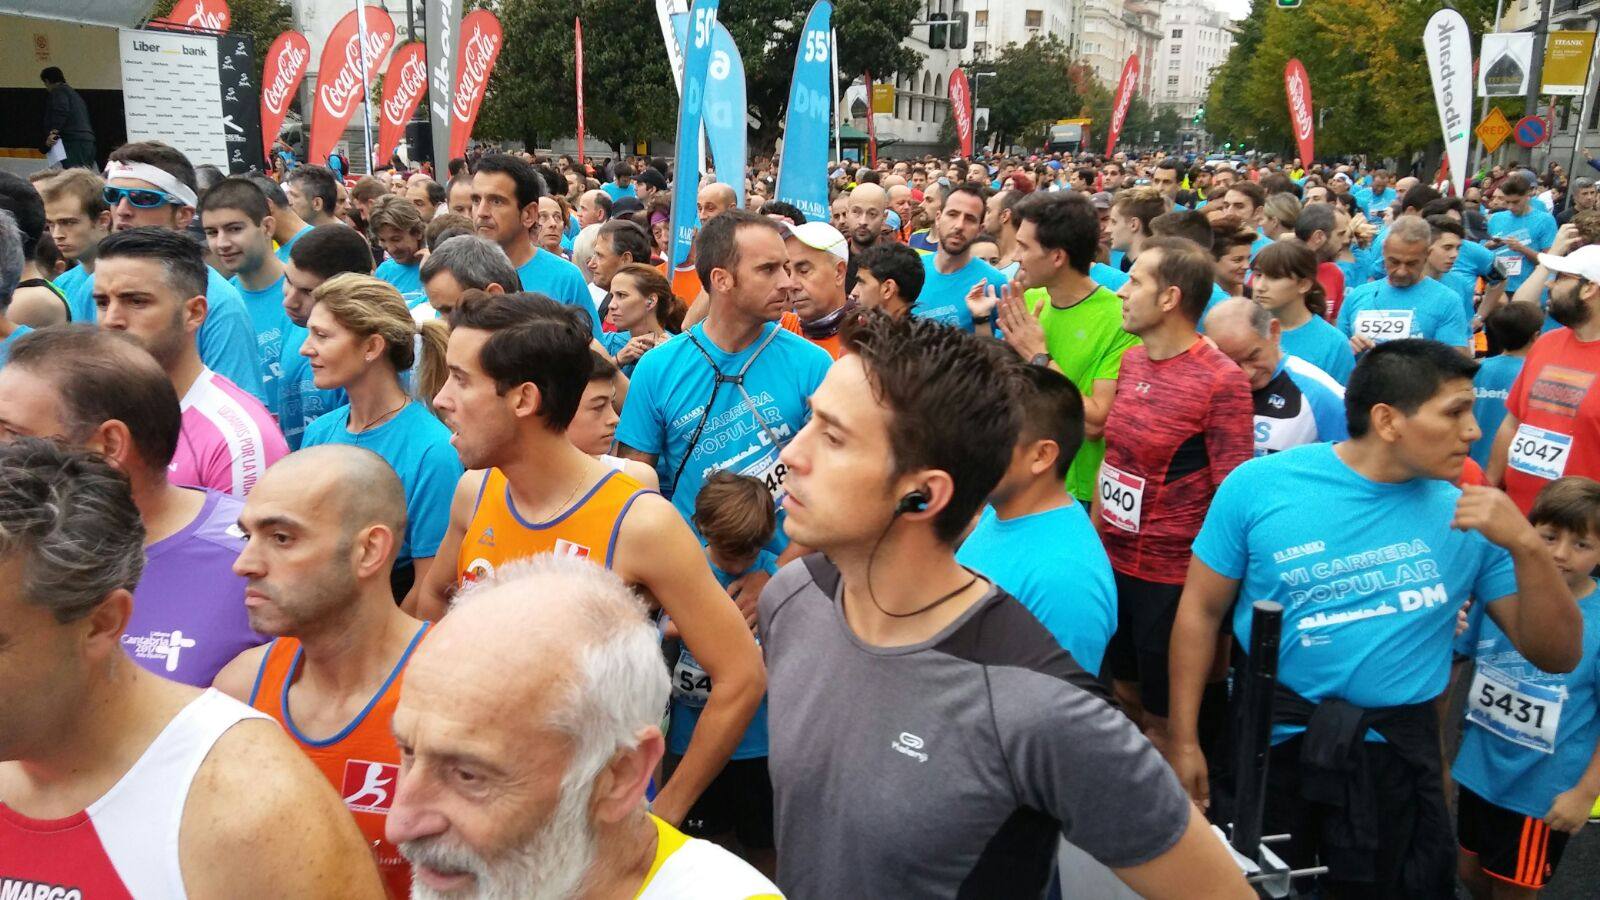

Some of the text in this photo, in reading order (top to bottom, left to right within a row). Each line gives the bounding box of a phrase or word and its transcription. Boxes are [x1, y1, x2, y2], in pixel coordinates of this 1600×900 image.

[132, 40, 207, 57] Liber bank
[1360, 320, 1405, 333] 5529
[702, 391, 775, 433] CARRERA
[240, 437, 256, 459] POR
[1513, 438, 1563, 463] 5047
[242, 459, 256, 472] LA
[1279, 538, 1431, 587] VI CARRERA
[1288, 559, 1440, 609] POPULAR
[1398, 583, 1448, 612] DM
[1478, 683, 1546, 729] 5431
